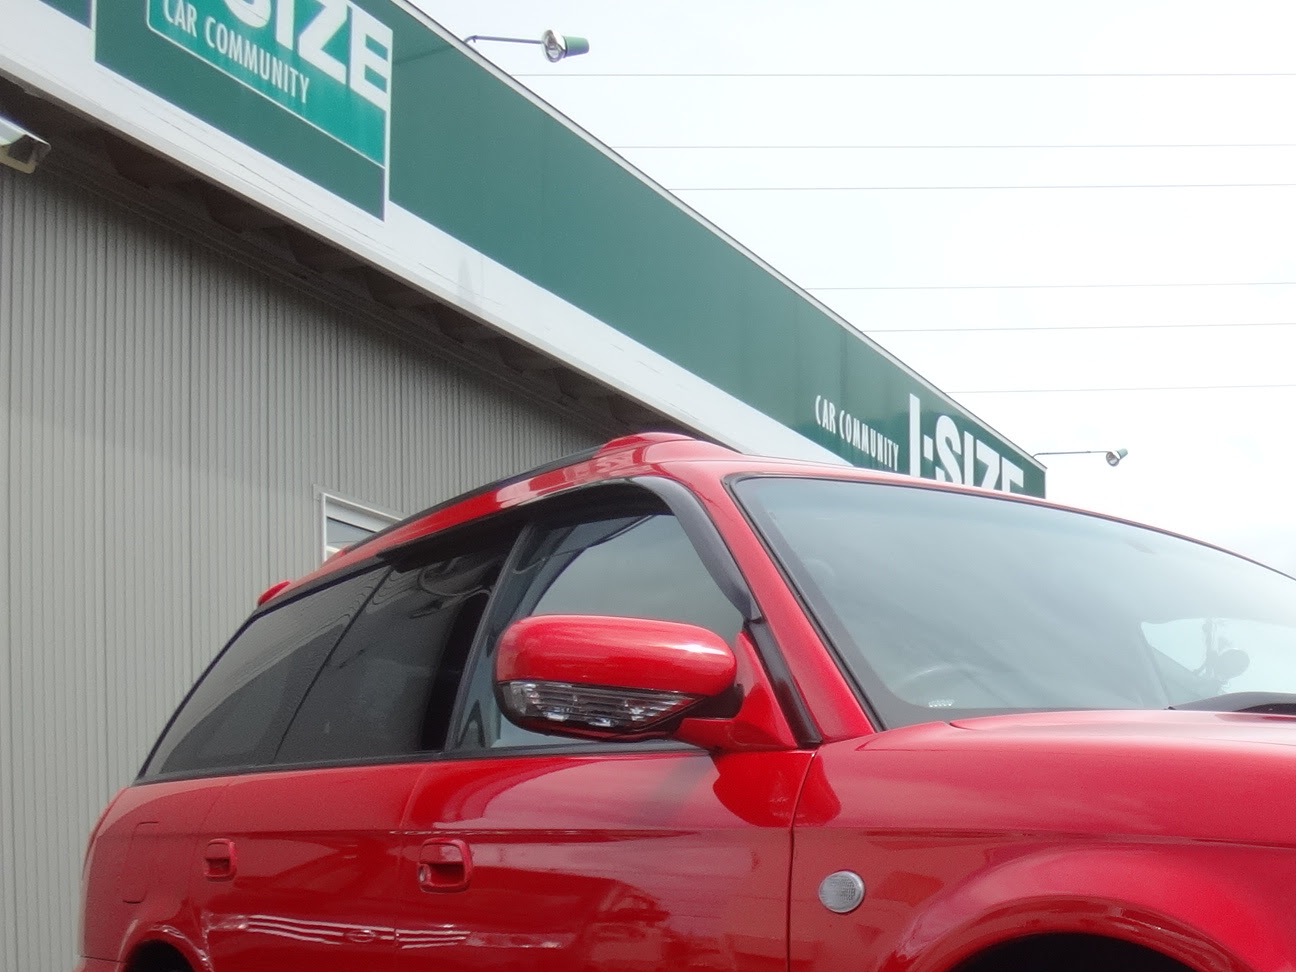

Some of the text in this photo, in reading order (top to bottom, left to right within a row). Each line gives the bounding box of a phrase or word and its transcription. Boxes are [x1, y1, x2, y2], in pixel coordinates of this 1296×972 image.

[163, 0, 309, 104] CAR COMMUNITY
[815, 395, 899, 472] CAR COMMUNITY
